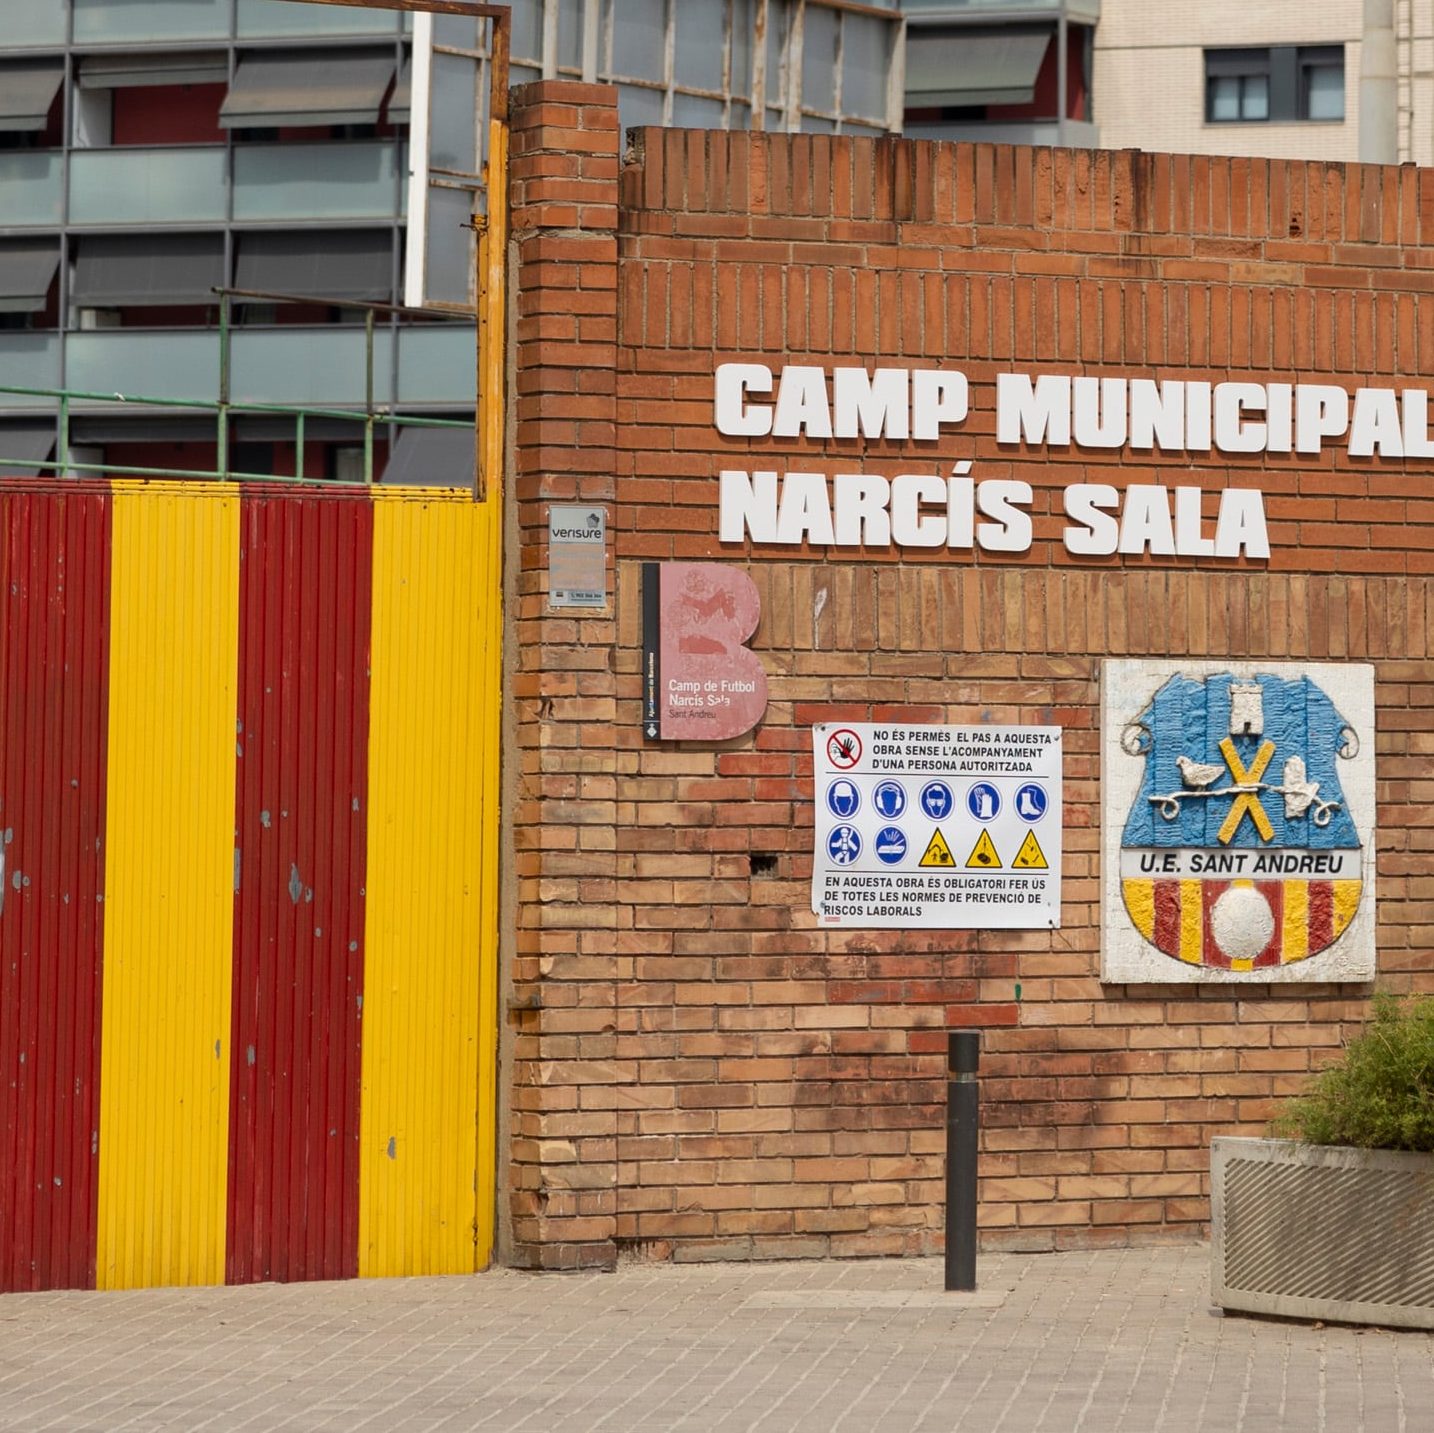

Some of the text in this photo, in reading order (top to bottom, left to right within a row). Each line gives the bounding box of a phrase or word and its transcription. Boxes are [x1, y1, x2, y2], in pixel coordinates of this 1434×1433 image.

[715, 363, 968, 441] CAMP
[718, 461, 1271, 559] NARCÍS SALA
[552, 527, 601, 539] verisure
[669, 679, 755, 693] Camp de Futbol
[669, 693, 730, 707] Narcís Sala
[669, 709, 716, 719] Sant Andreu
[874, 728, 1051, 745] NO ÉS PERMÈS EL PAS A AQUESTA
[873, 745, 1043, 758] OBRA SENSE L'ACOMPANYAMENT
[872, 760, 1032, 772] D'UNA PERSONA AUTORITZADA
[1140, 853, 1343, 873] U.E. SANT ANDREU
[825, 876, 1046, 890] EN AQUESTA OBRA ÉS OBLIGATORI FER ÚS
[824, 891, 1041, 904] DE TOTES LES NORMES DE PREVENCIÓ DE
[824, 905, 922, 917] RISCOS LABORALS
